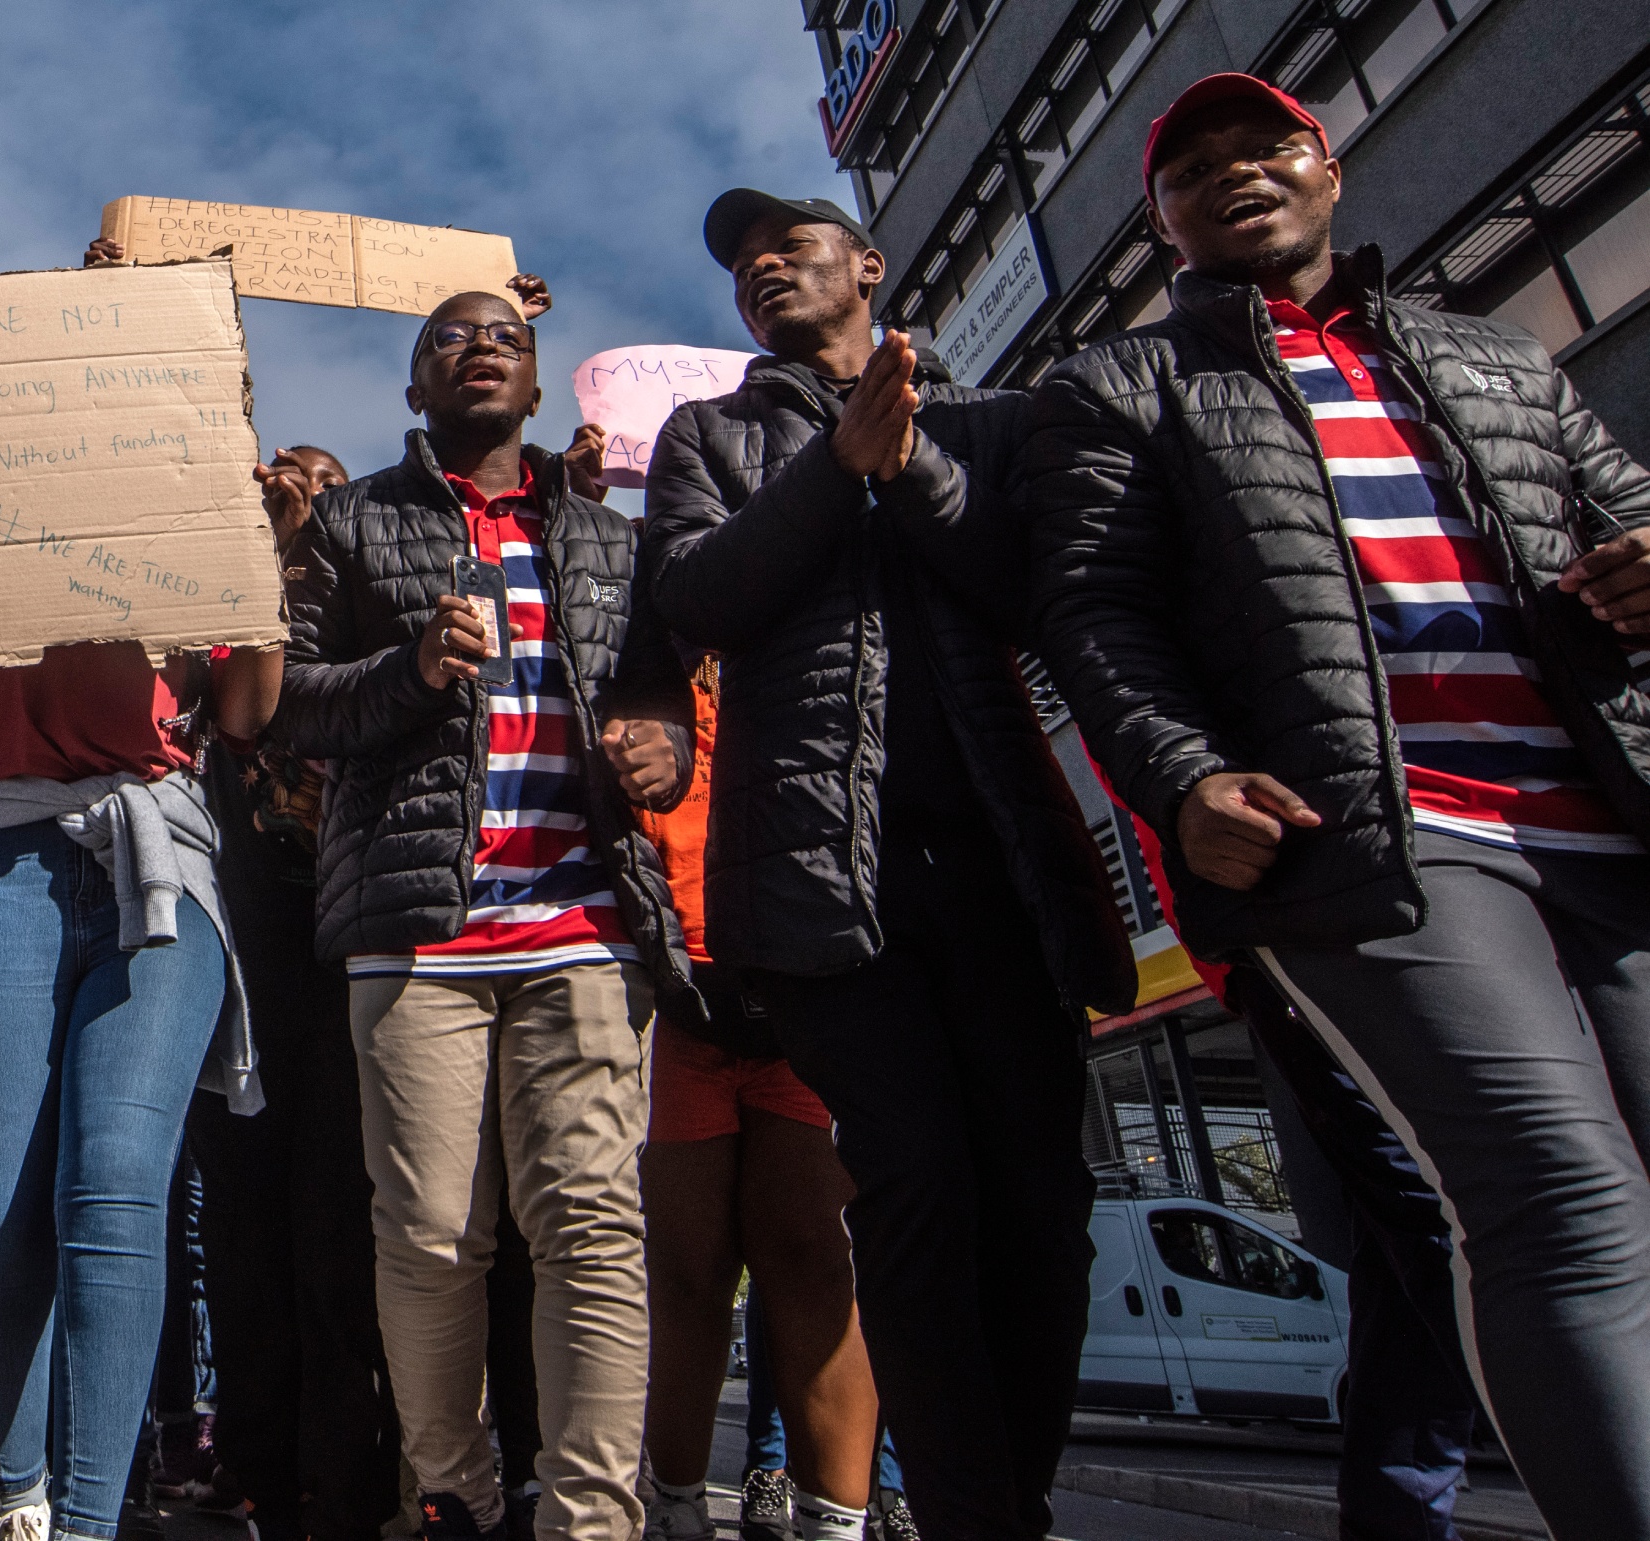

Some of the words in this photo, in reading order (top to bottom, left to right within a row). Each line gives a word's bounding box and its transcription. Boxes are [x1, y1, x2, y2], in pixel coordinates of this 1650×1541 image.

[825, 0, 891, 131] BDO
[977, 246, 1031, 323] TEMPLER
[61, 302, 125, 334] NOT
[985, 272, 1037, 343] ENGINEERS
[85, 366, 206, 392] ANYWHERE
[110, 429, 188, 458] funding
[87, 545, 127, 577] ARE
[142, 560, 199, 596] TIRED
[599, 585, 619, 595] UFS
